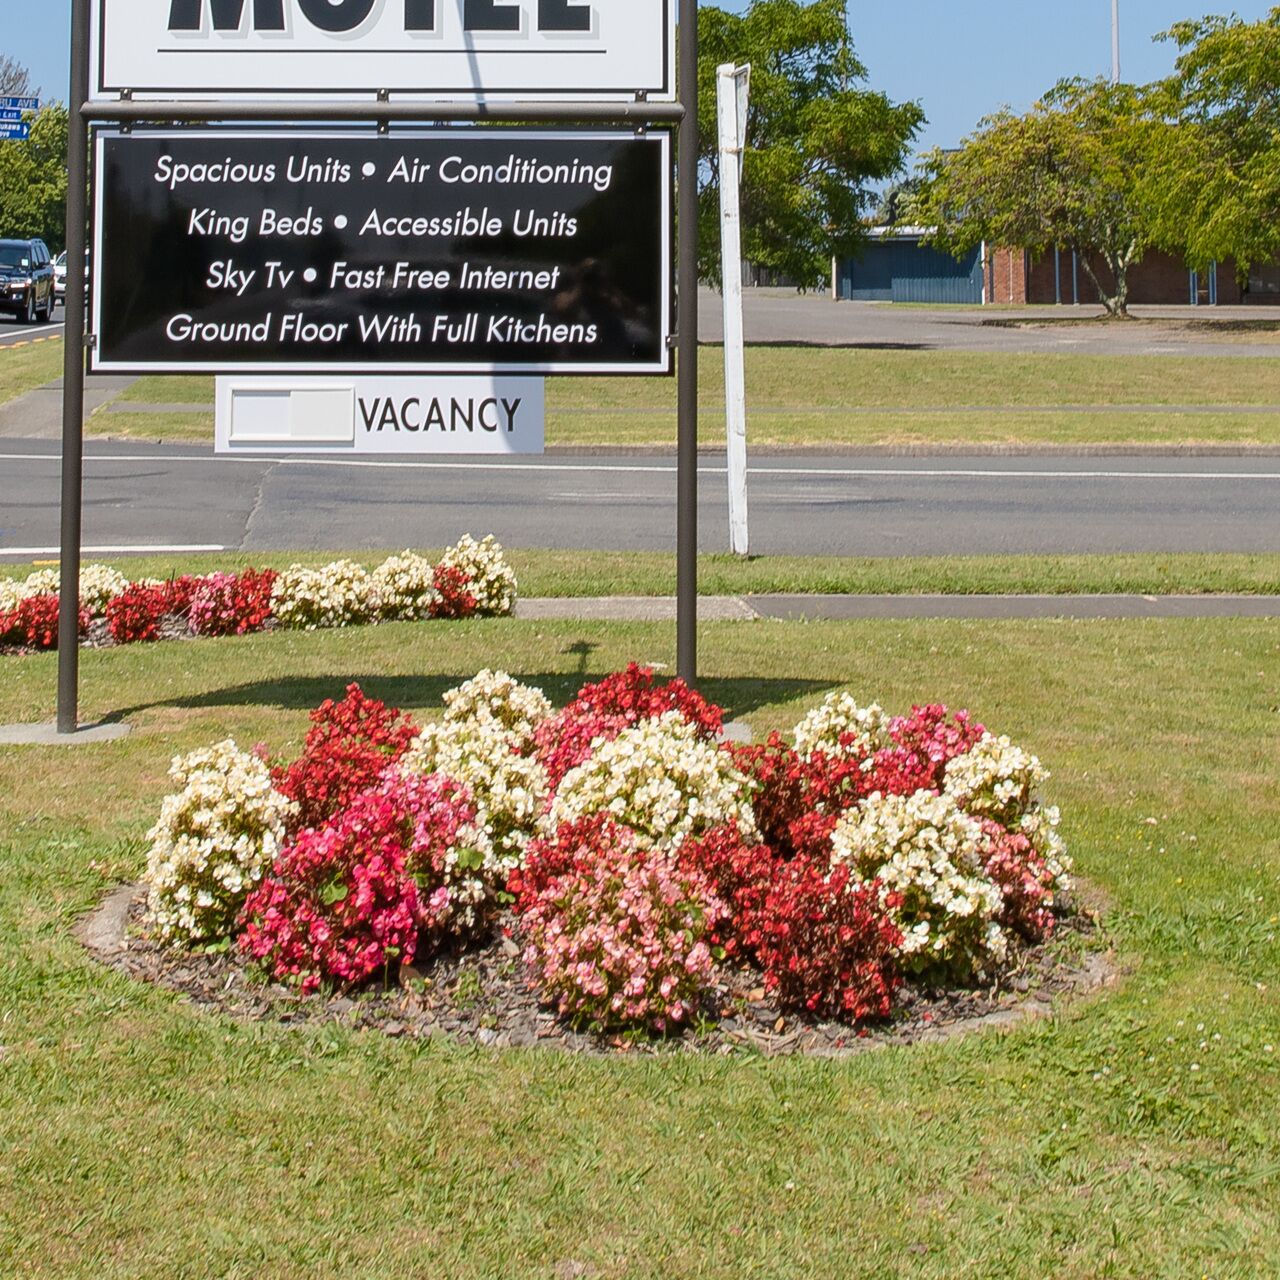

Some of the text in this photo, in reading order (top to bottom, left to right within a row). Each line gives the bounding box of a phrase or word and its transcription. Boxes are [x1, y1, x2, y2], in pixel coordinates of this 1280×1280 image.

[3, 111, 17, 119] Exit
[17, 99, 36, 108] AVE
[153, 154, 613, 192] Spacious Units Air Conditioning
[187, 206, 578, 243] King Beds Accessible Units
[205, 259, 562, 297] Sky Tv Fast Free Internet
[165, 312, 598, 344] Ground Floor With Full Kitchens
[357, 396, 523, 433] VACANCY
